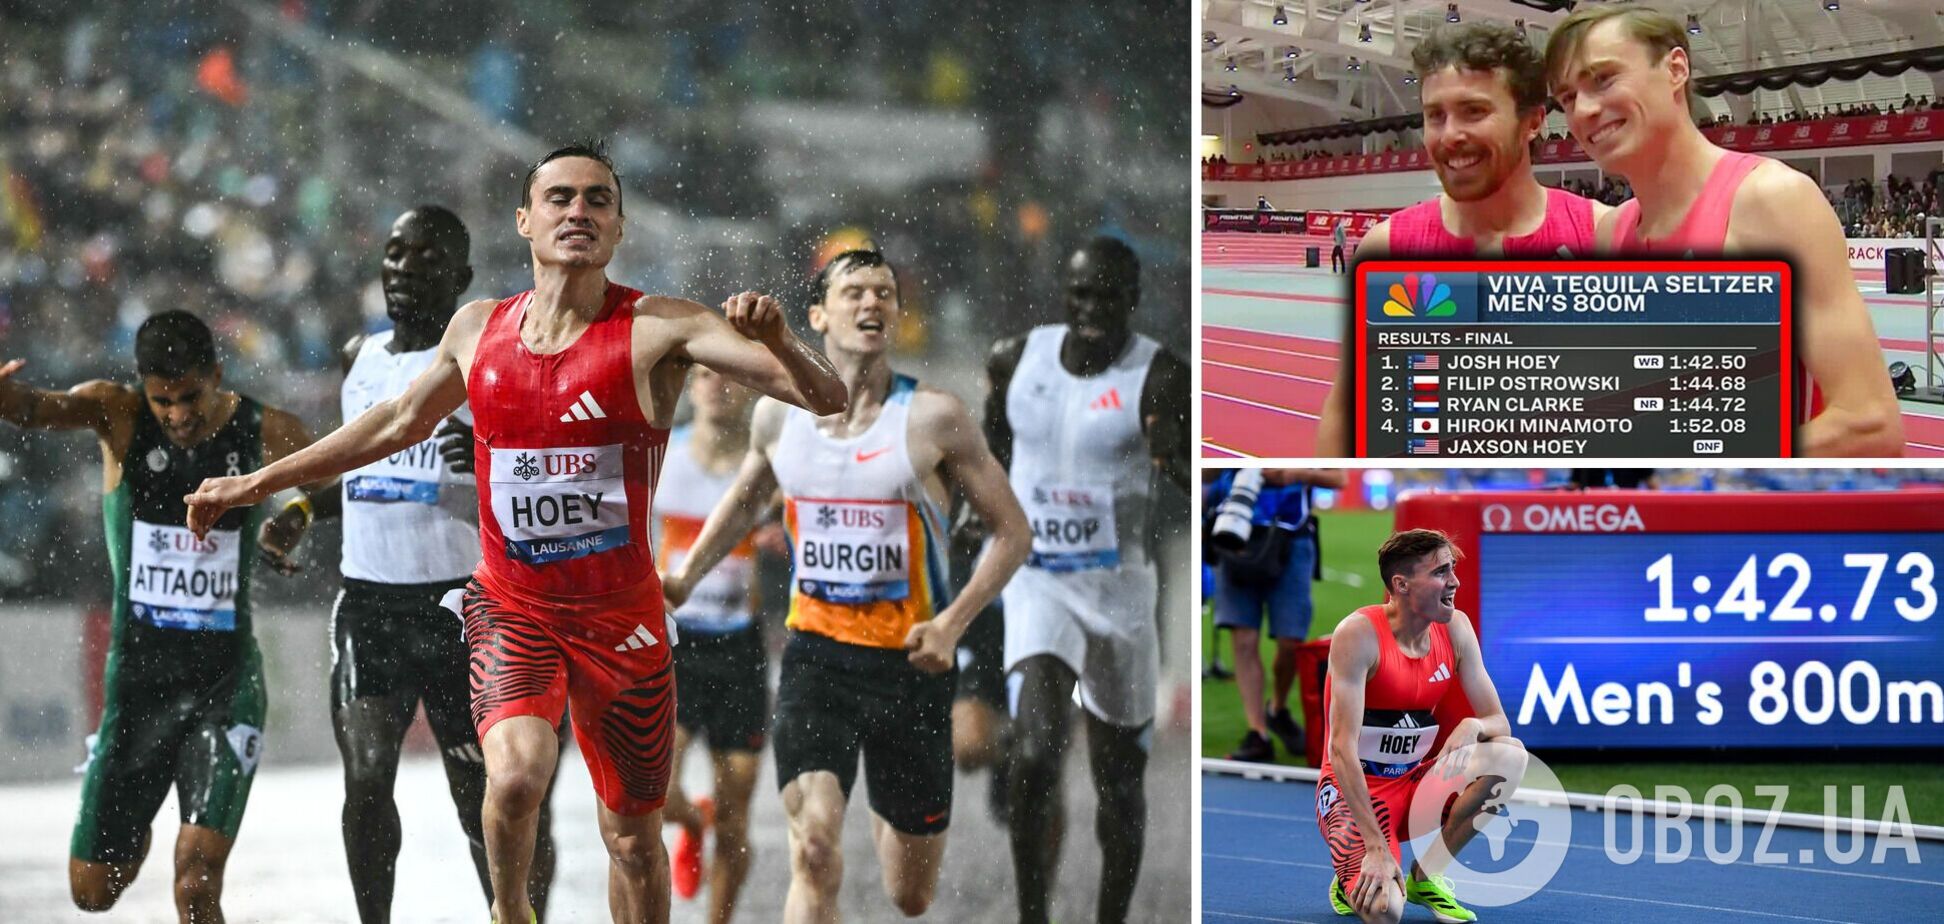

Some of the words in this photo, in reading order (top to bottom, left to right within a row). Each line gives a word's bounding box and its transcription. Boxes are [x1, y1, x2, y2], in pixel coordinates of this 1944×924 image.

[543, 453, 598, 476] UBS
[511, 491, 604, 528] HOEY
[841, 508, 885, 528] UBS
[1523, 504, 1645, 532] OMEGA
[530, 534, 605, 557] LAUSANNE
[803, 541, 904, 572] BURGIN
[1644, 551, 1938, 623] 1:42.73
[1517, 662, 1724, 726] Men's
[1748, 660, 1944, 725] 800m
[244, 734, 257, 760] 6
[1380, 735, 1421, 754] HOEY
[1383, 767, 1408, 775] PARIS
